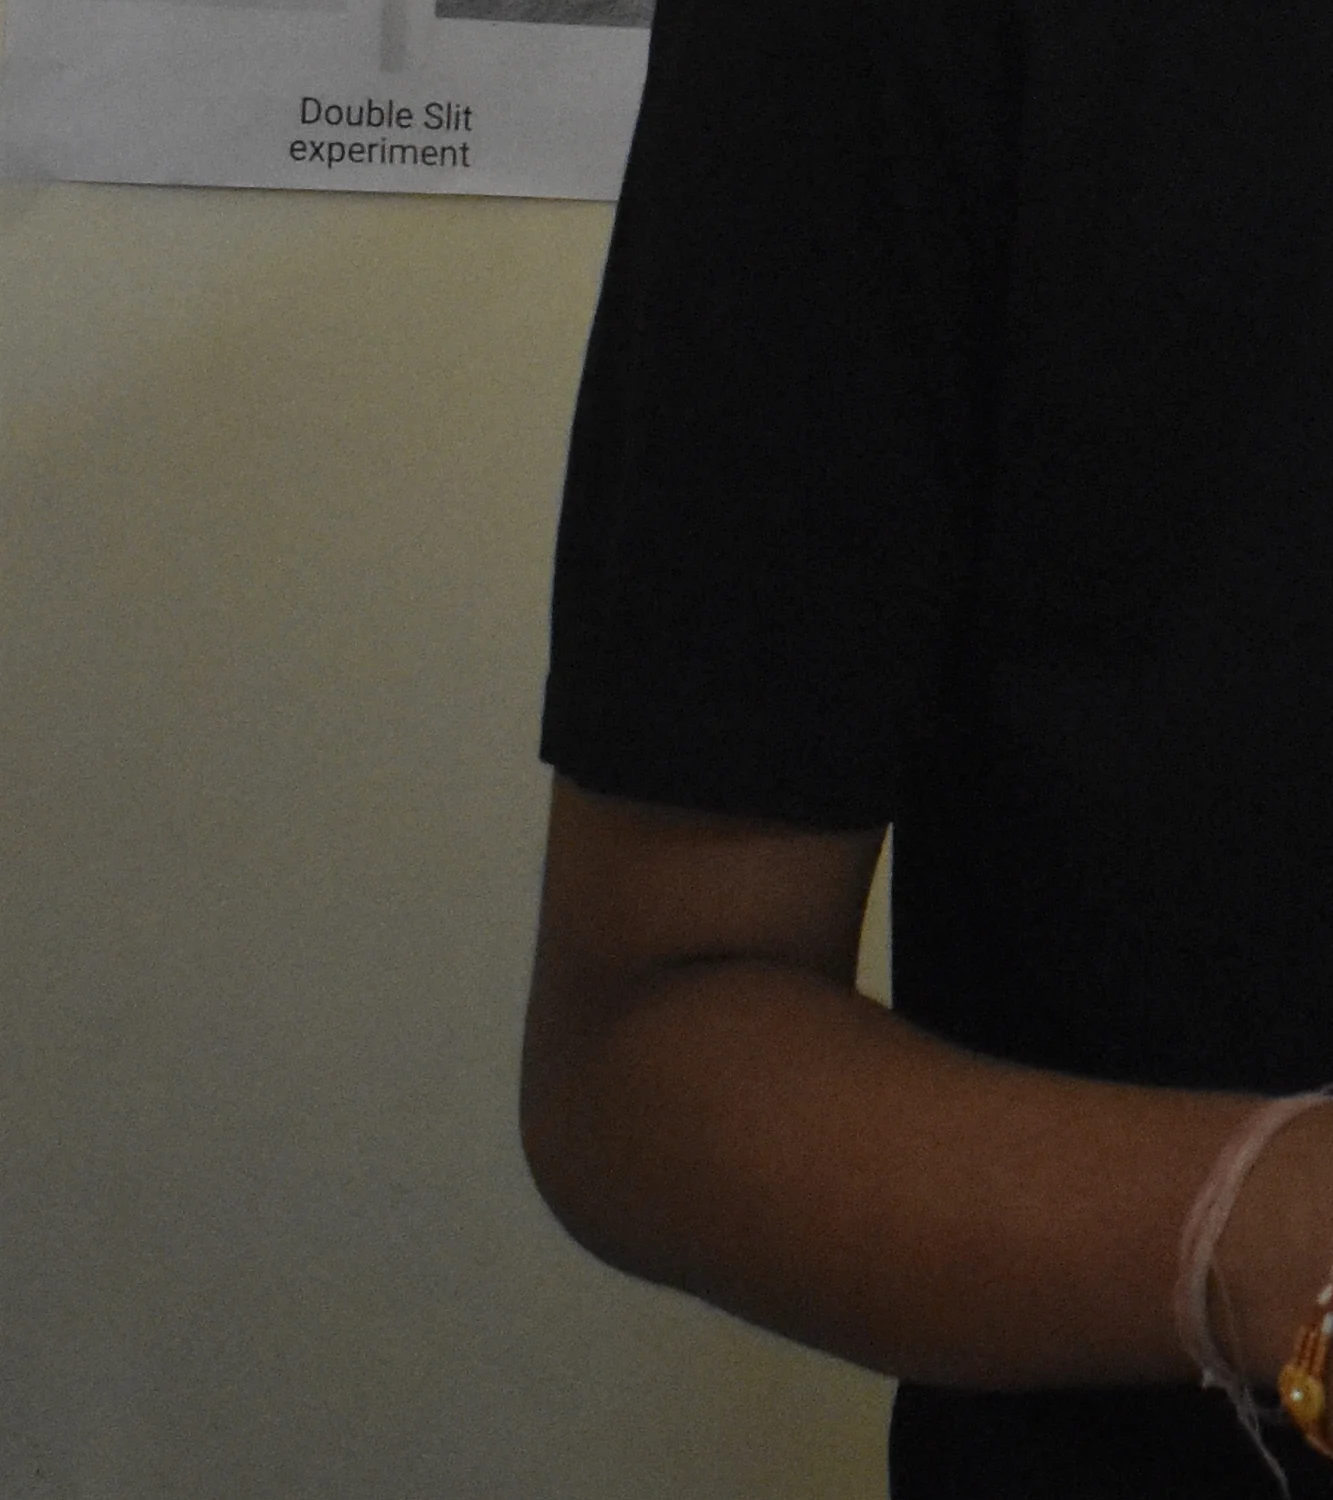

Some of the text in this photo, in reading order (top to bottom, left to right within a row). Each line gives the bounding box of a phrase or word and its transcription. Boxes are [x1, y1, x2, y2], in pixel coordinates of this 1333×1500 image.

[300, 96, 473, 133] Double Slit
[289, 135, 470, 172] experiment
